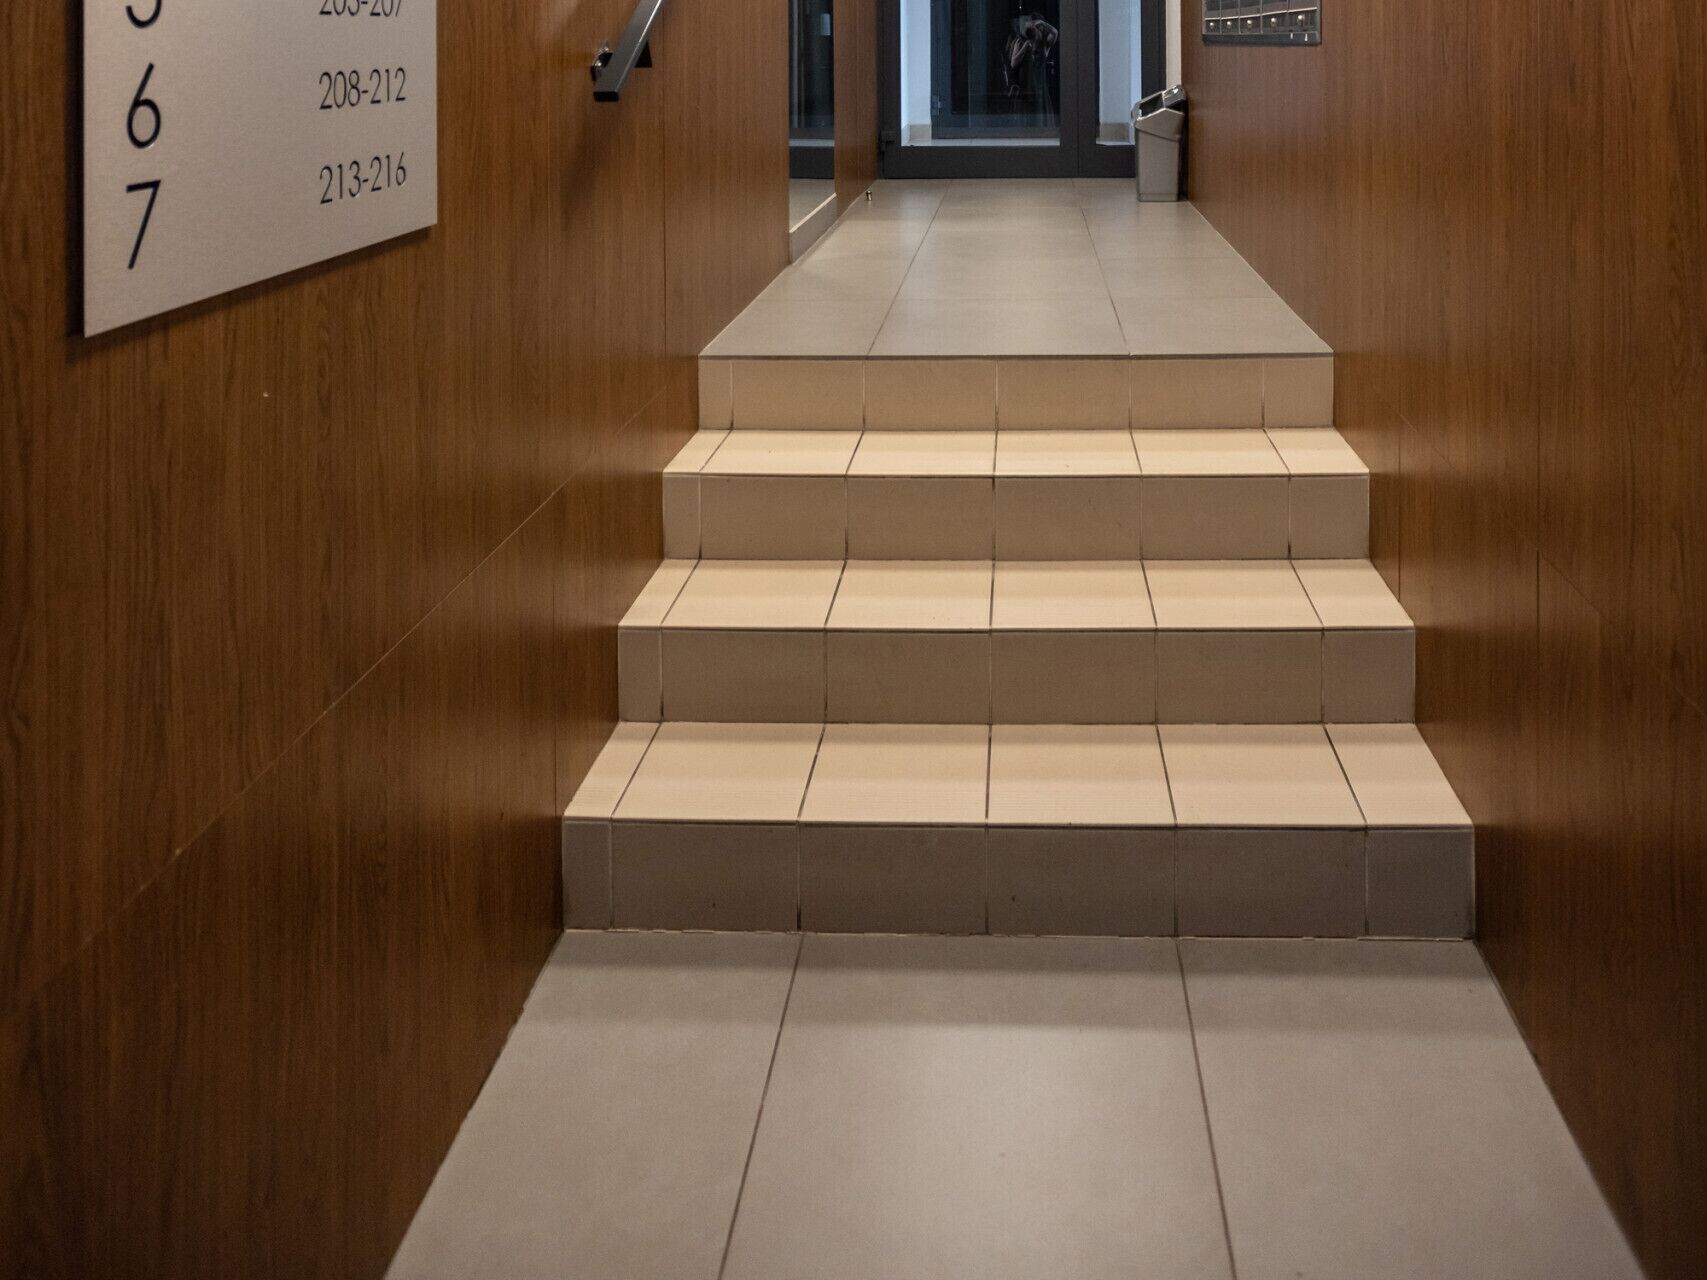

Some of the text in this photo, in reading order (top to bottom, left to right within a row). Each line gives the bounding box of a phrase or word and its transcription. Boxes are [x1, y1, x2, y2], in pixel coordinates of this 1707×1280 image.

[125, 61, 163, 150] 6
[318, 66, 407, 111] 208-212
[318, 151, 407, 205] 213-216
[125, 178, 162, 271] 7
